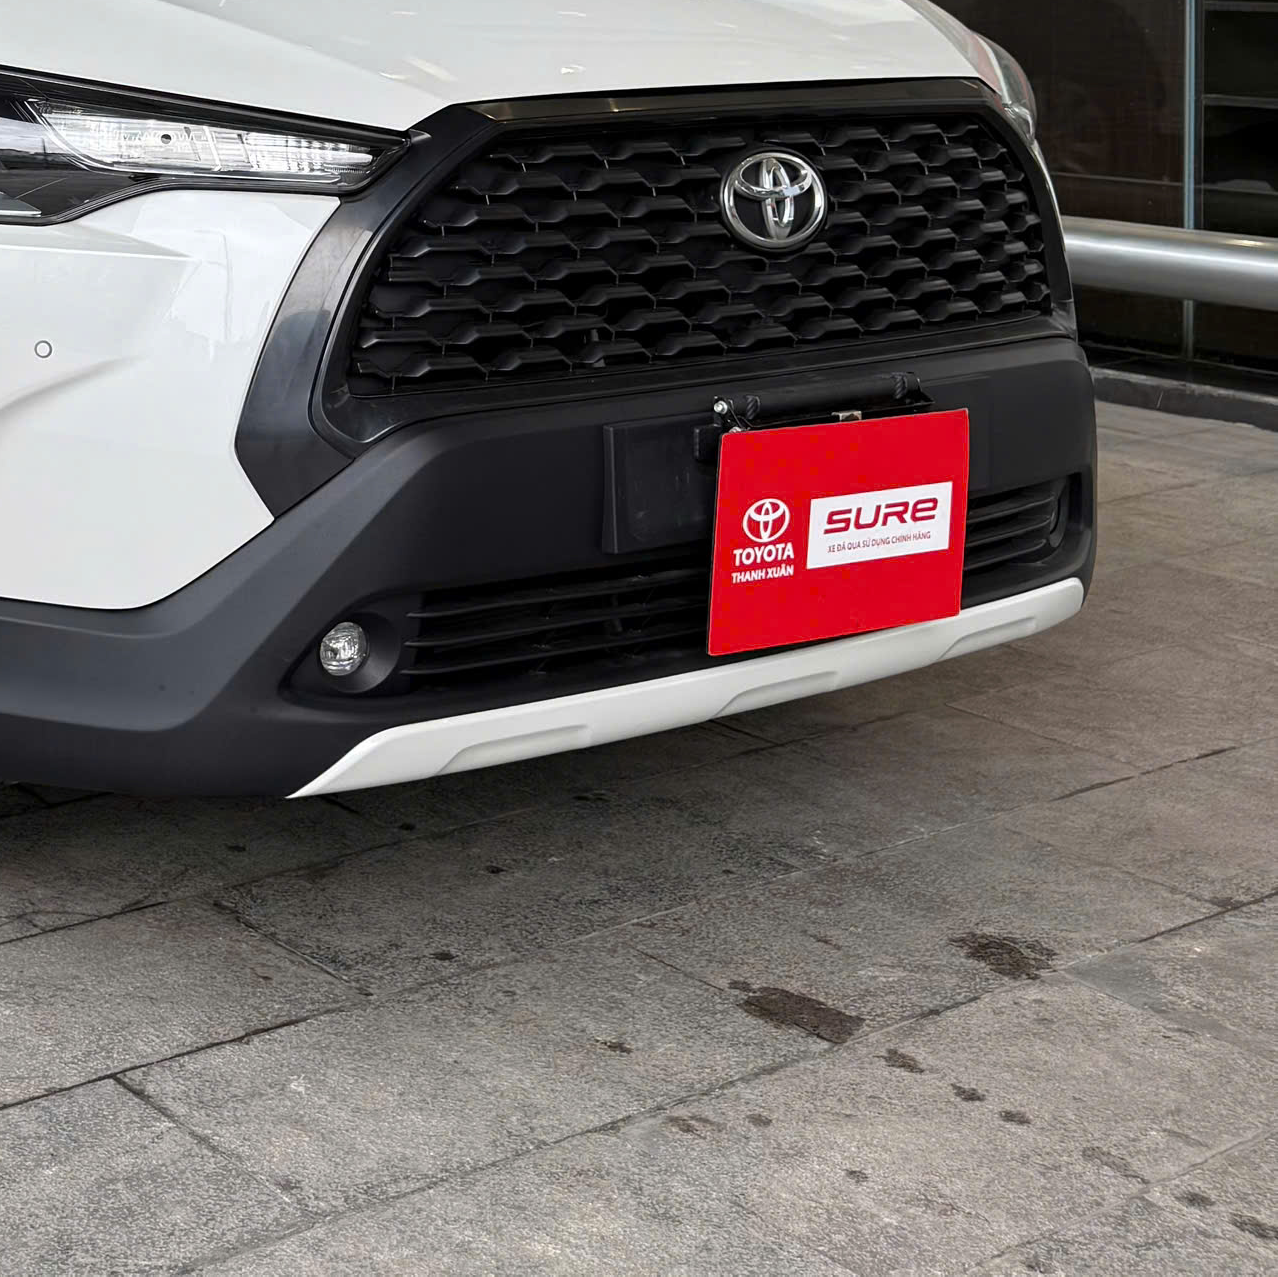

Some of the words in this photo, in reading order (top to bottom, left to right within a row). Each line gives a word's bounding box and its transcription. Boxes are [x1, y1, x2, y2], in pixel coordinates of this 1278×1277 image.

[733, 541, 794, 567] TOYOTA
[827, 544, 836, 553] XE
[847, 540, 862, 551] QUA
[731, 568, 766, 584] THANH
[767, 564, 794, 578] XUÂN
